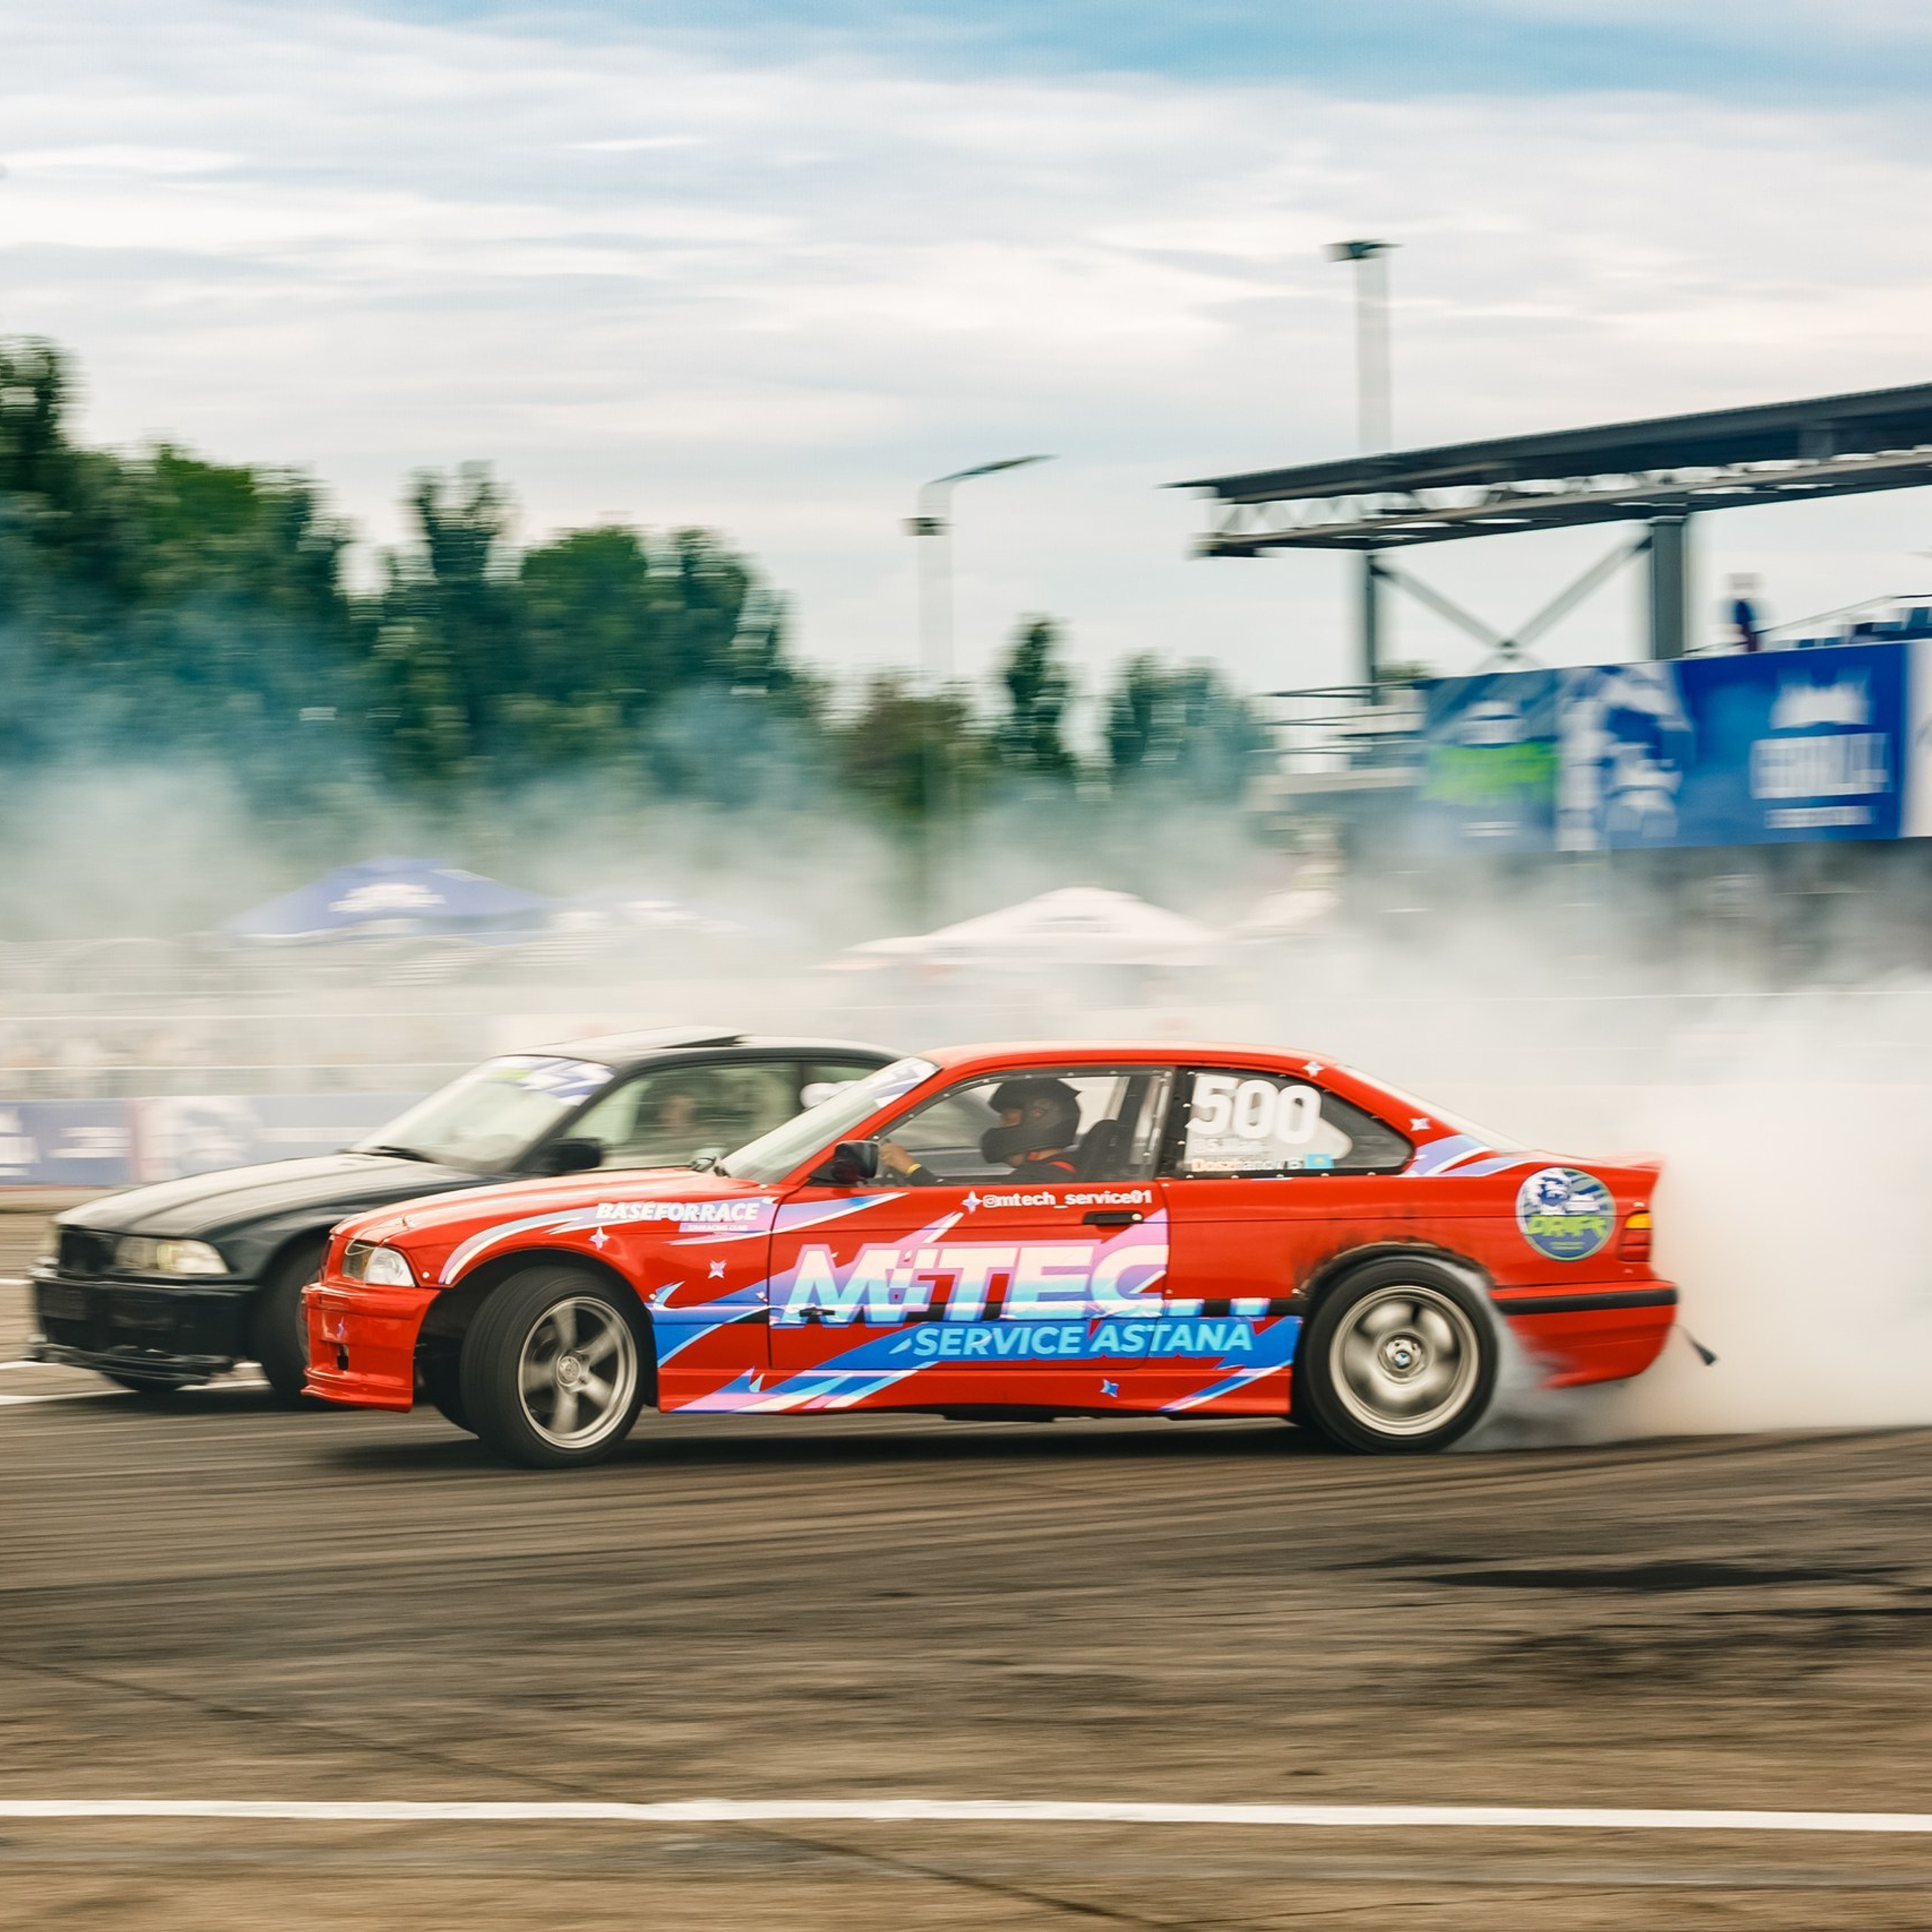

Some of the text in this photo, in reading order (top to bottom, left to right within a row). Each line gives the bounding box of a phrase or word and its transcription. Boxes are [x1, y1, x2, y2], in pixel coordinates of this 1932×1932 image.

[1185, 1073, 1321, 1144] 500
[595, 1201, 760, 1222] BASEFORRACE
[983, 1189, 1152, 1209] @mtech_service01
[912, 1324, 1254, 1356] SERVICE ASTANA
